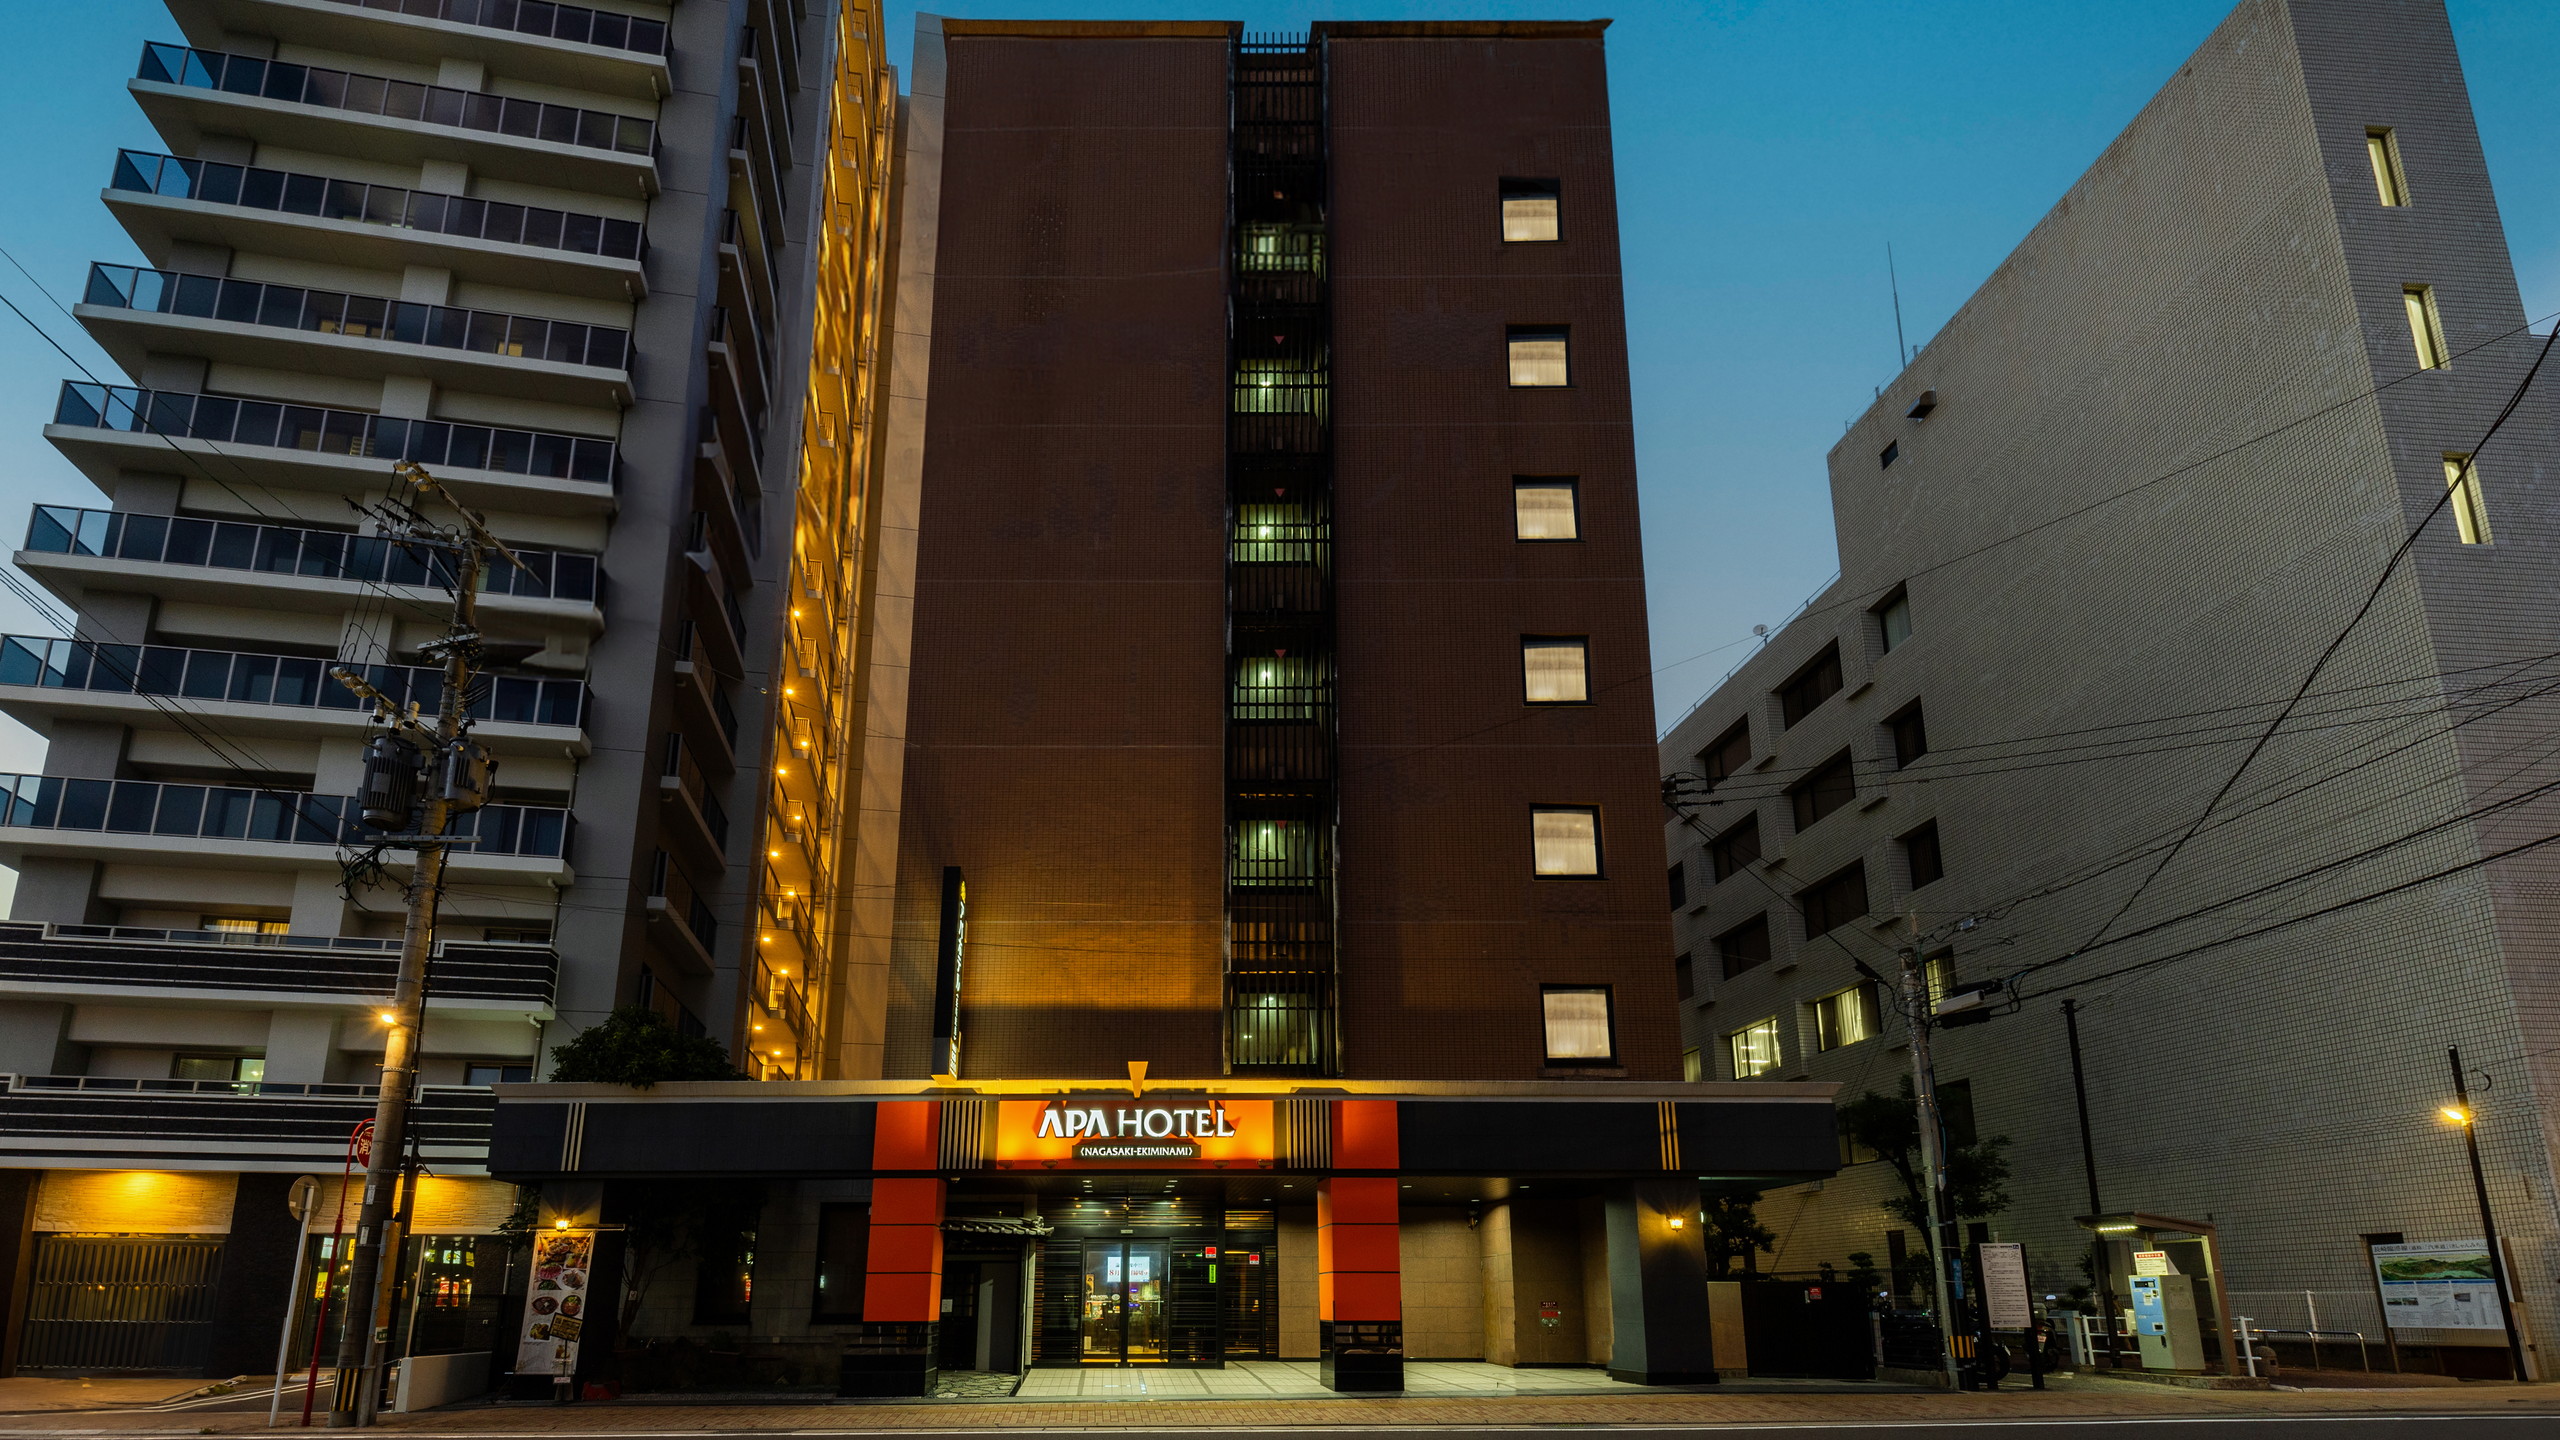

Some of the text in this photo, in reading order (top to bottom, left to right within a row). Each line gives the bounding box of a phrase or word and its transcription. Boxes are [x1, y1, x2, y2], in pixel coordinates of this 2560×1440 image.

[1037, 1109, 1236, 1138] APA HOTEL
[359, 1138, 373, 1155] 消
